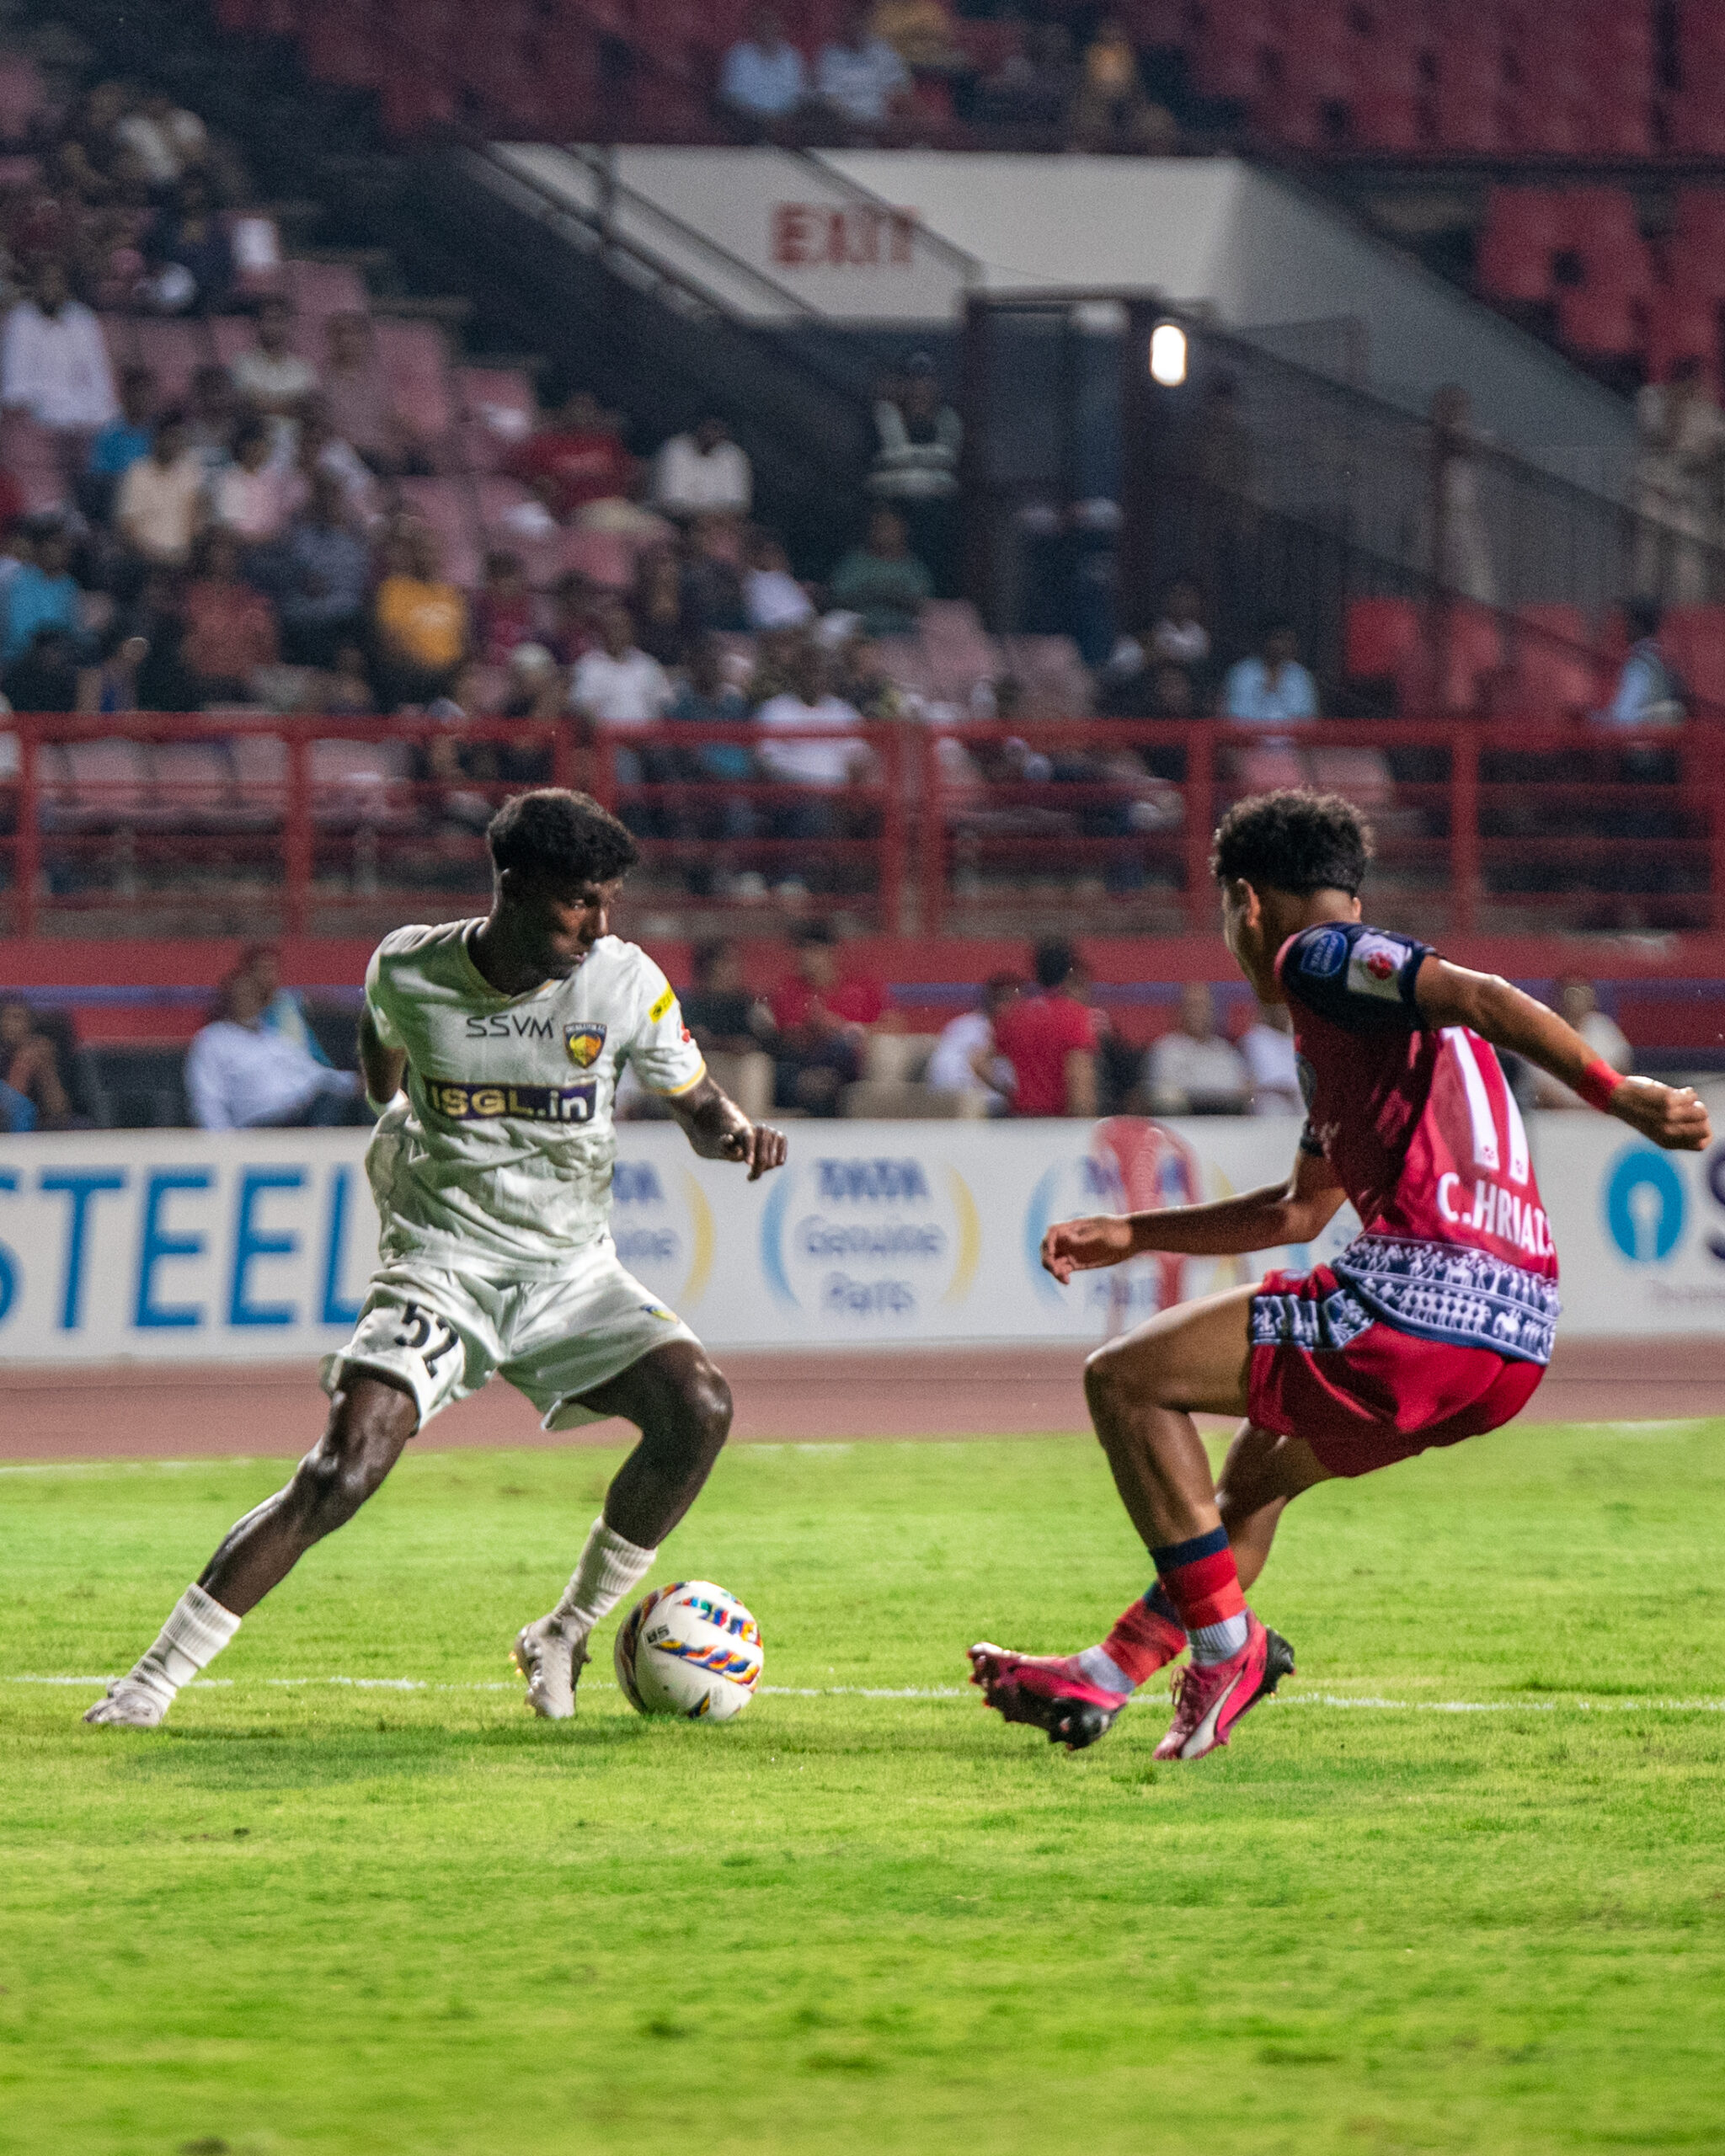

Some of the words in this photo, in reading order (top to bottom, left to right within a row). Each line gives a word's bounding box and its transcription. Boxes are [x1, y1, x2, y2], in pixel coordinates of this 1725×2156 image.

[466, 1014, 554, 1038] SSVM
[431, 1086, 589, 1119] ISGL.in
[817, 1158, 932, 1199] TATA
[394, 1299, 459, 1379] 52
